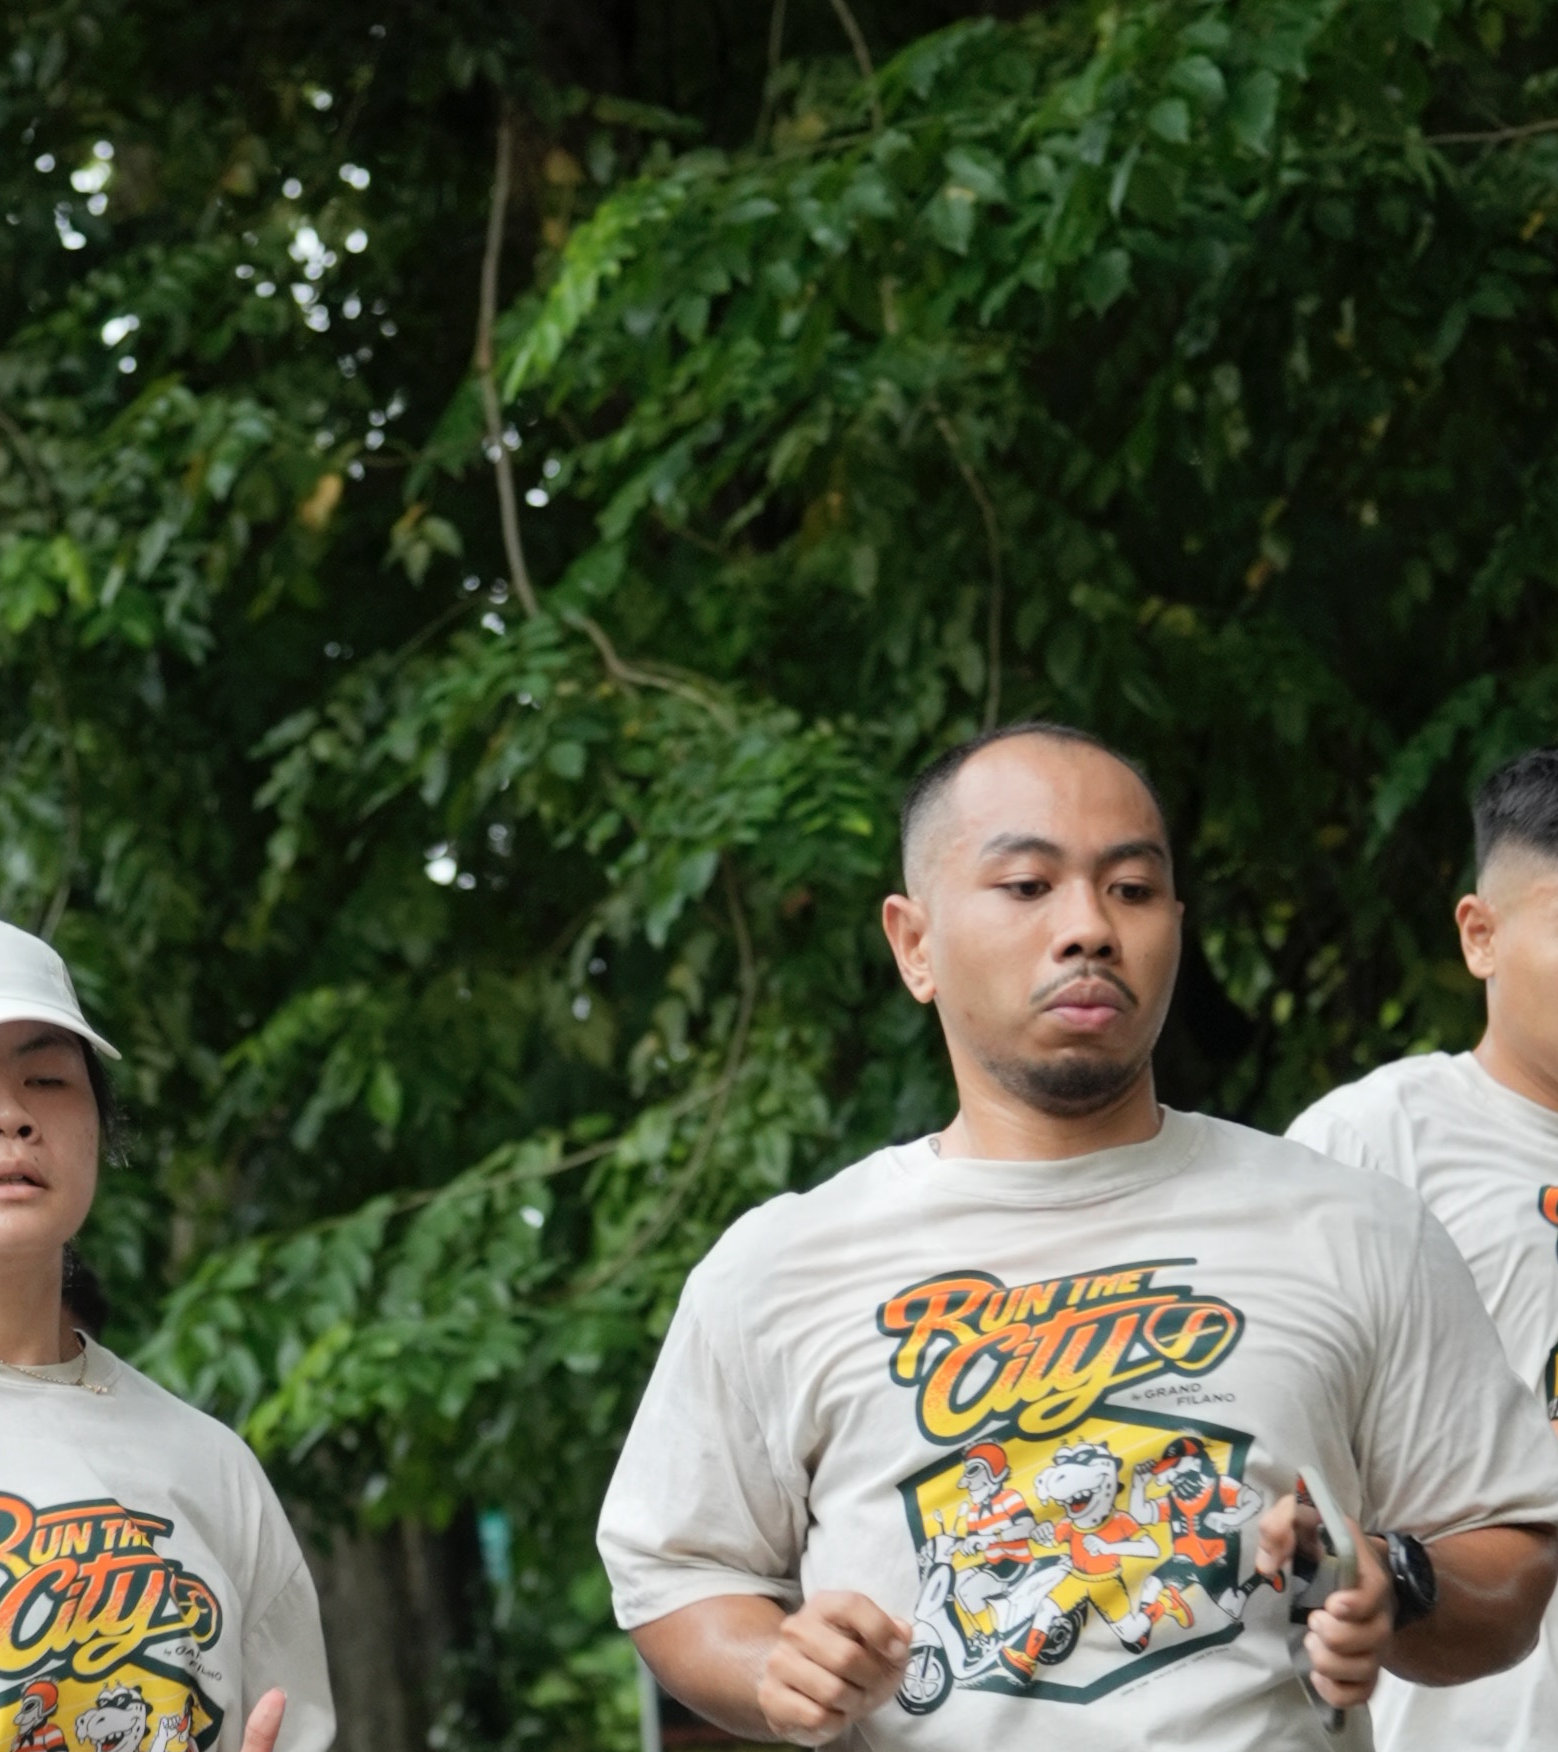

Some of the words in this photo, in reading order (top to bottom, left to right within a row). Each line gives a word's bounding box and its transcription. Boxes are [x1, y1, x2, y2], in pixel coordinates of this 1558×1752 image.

[1066, 1271, 1143, 1306] THE
[1144, 1382, 1202, 1400] GRAND
[1176, 1392, 1236, 1407] FILANO
